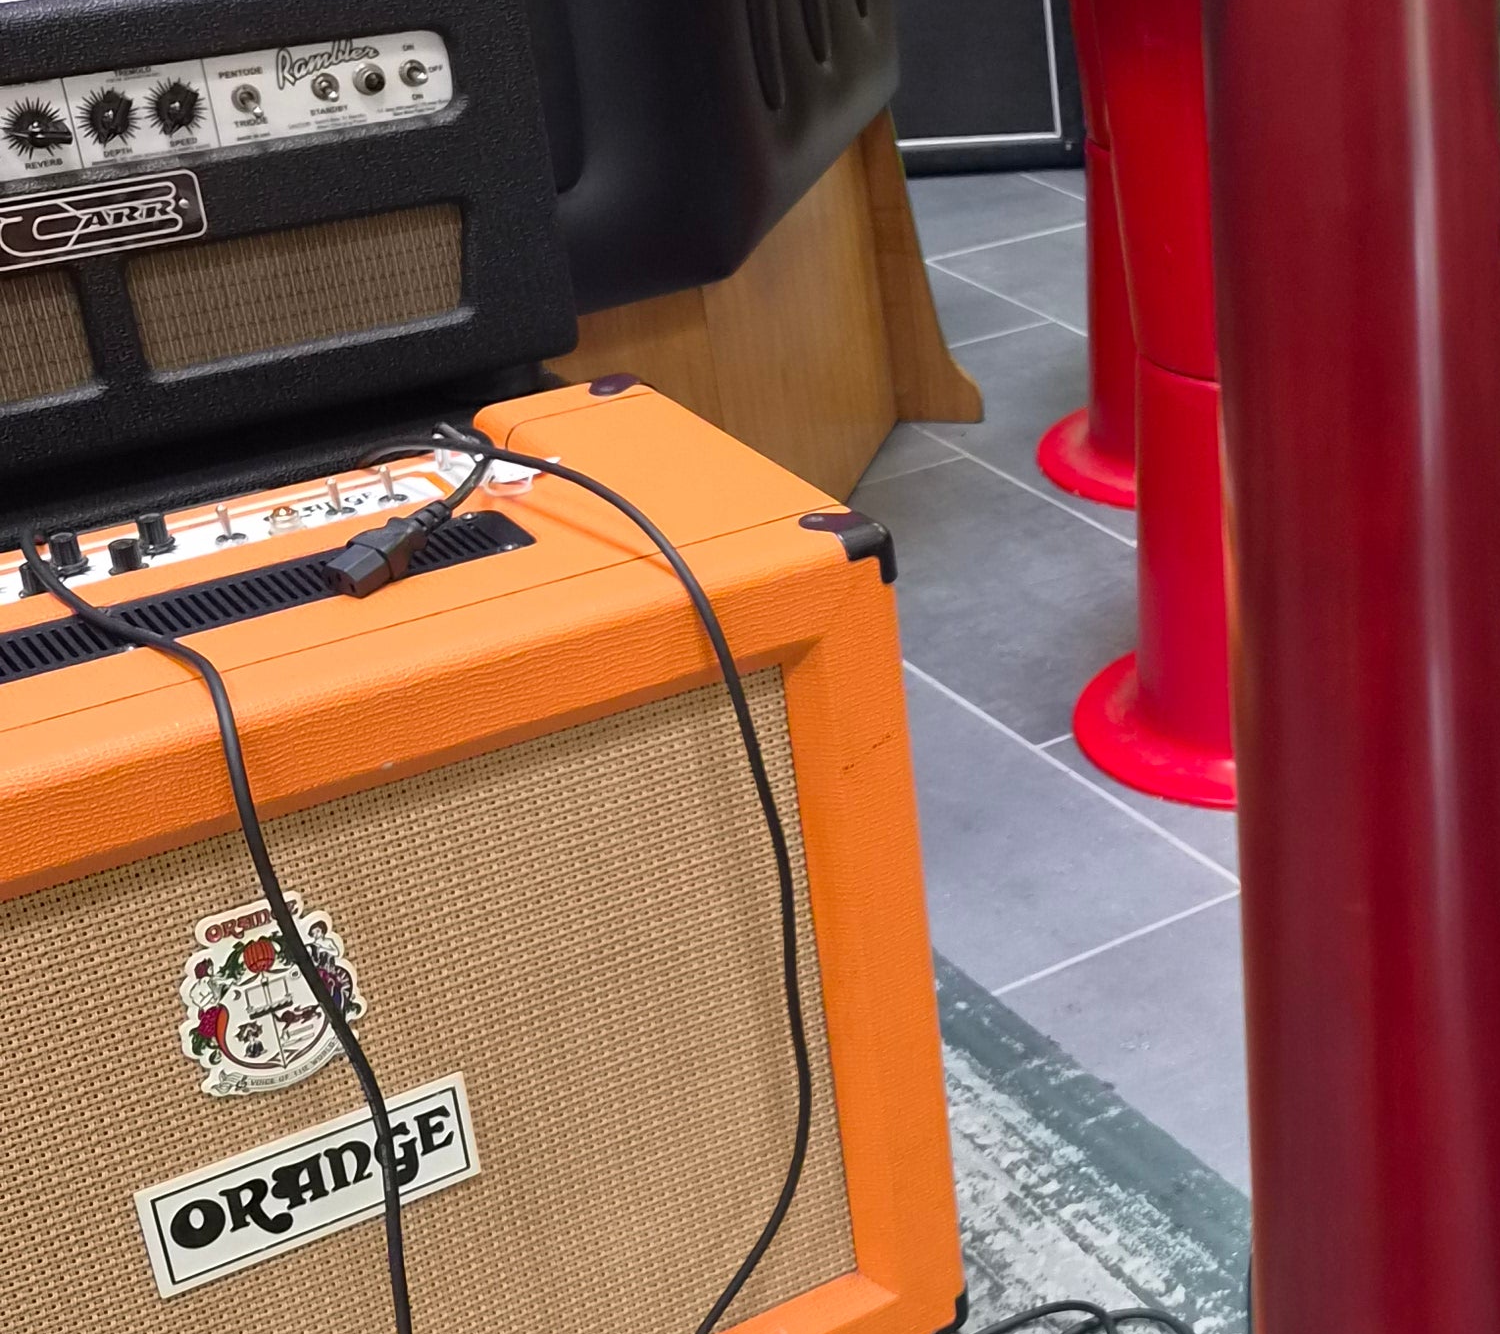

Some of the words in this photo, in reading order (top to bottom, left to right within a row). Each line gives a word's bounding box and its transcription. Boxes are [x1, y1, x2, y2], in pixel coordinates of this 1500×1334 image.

[275, 38, 380, 90] Rambler
[218, 66, 264, 80] PENTODE
[309, 104, 349, 117] STANDBY
[169, 136, 198, 148] SPEED
[103, 147, 133, 158] DEPTH
[24, 157, 64, 171] REVERB
[0, 181, 183, 257] CARR
[205, 900, 299, 943] ORAN
[169, 1104, 455, 1250] ORANGE
